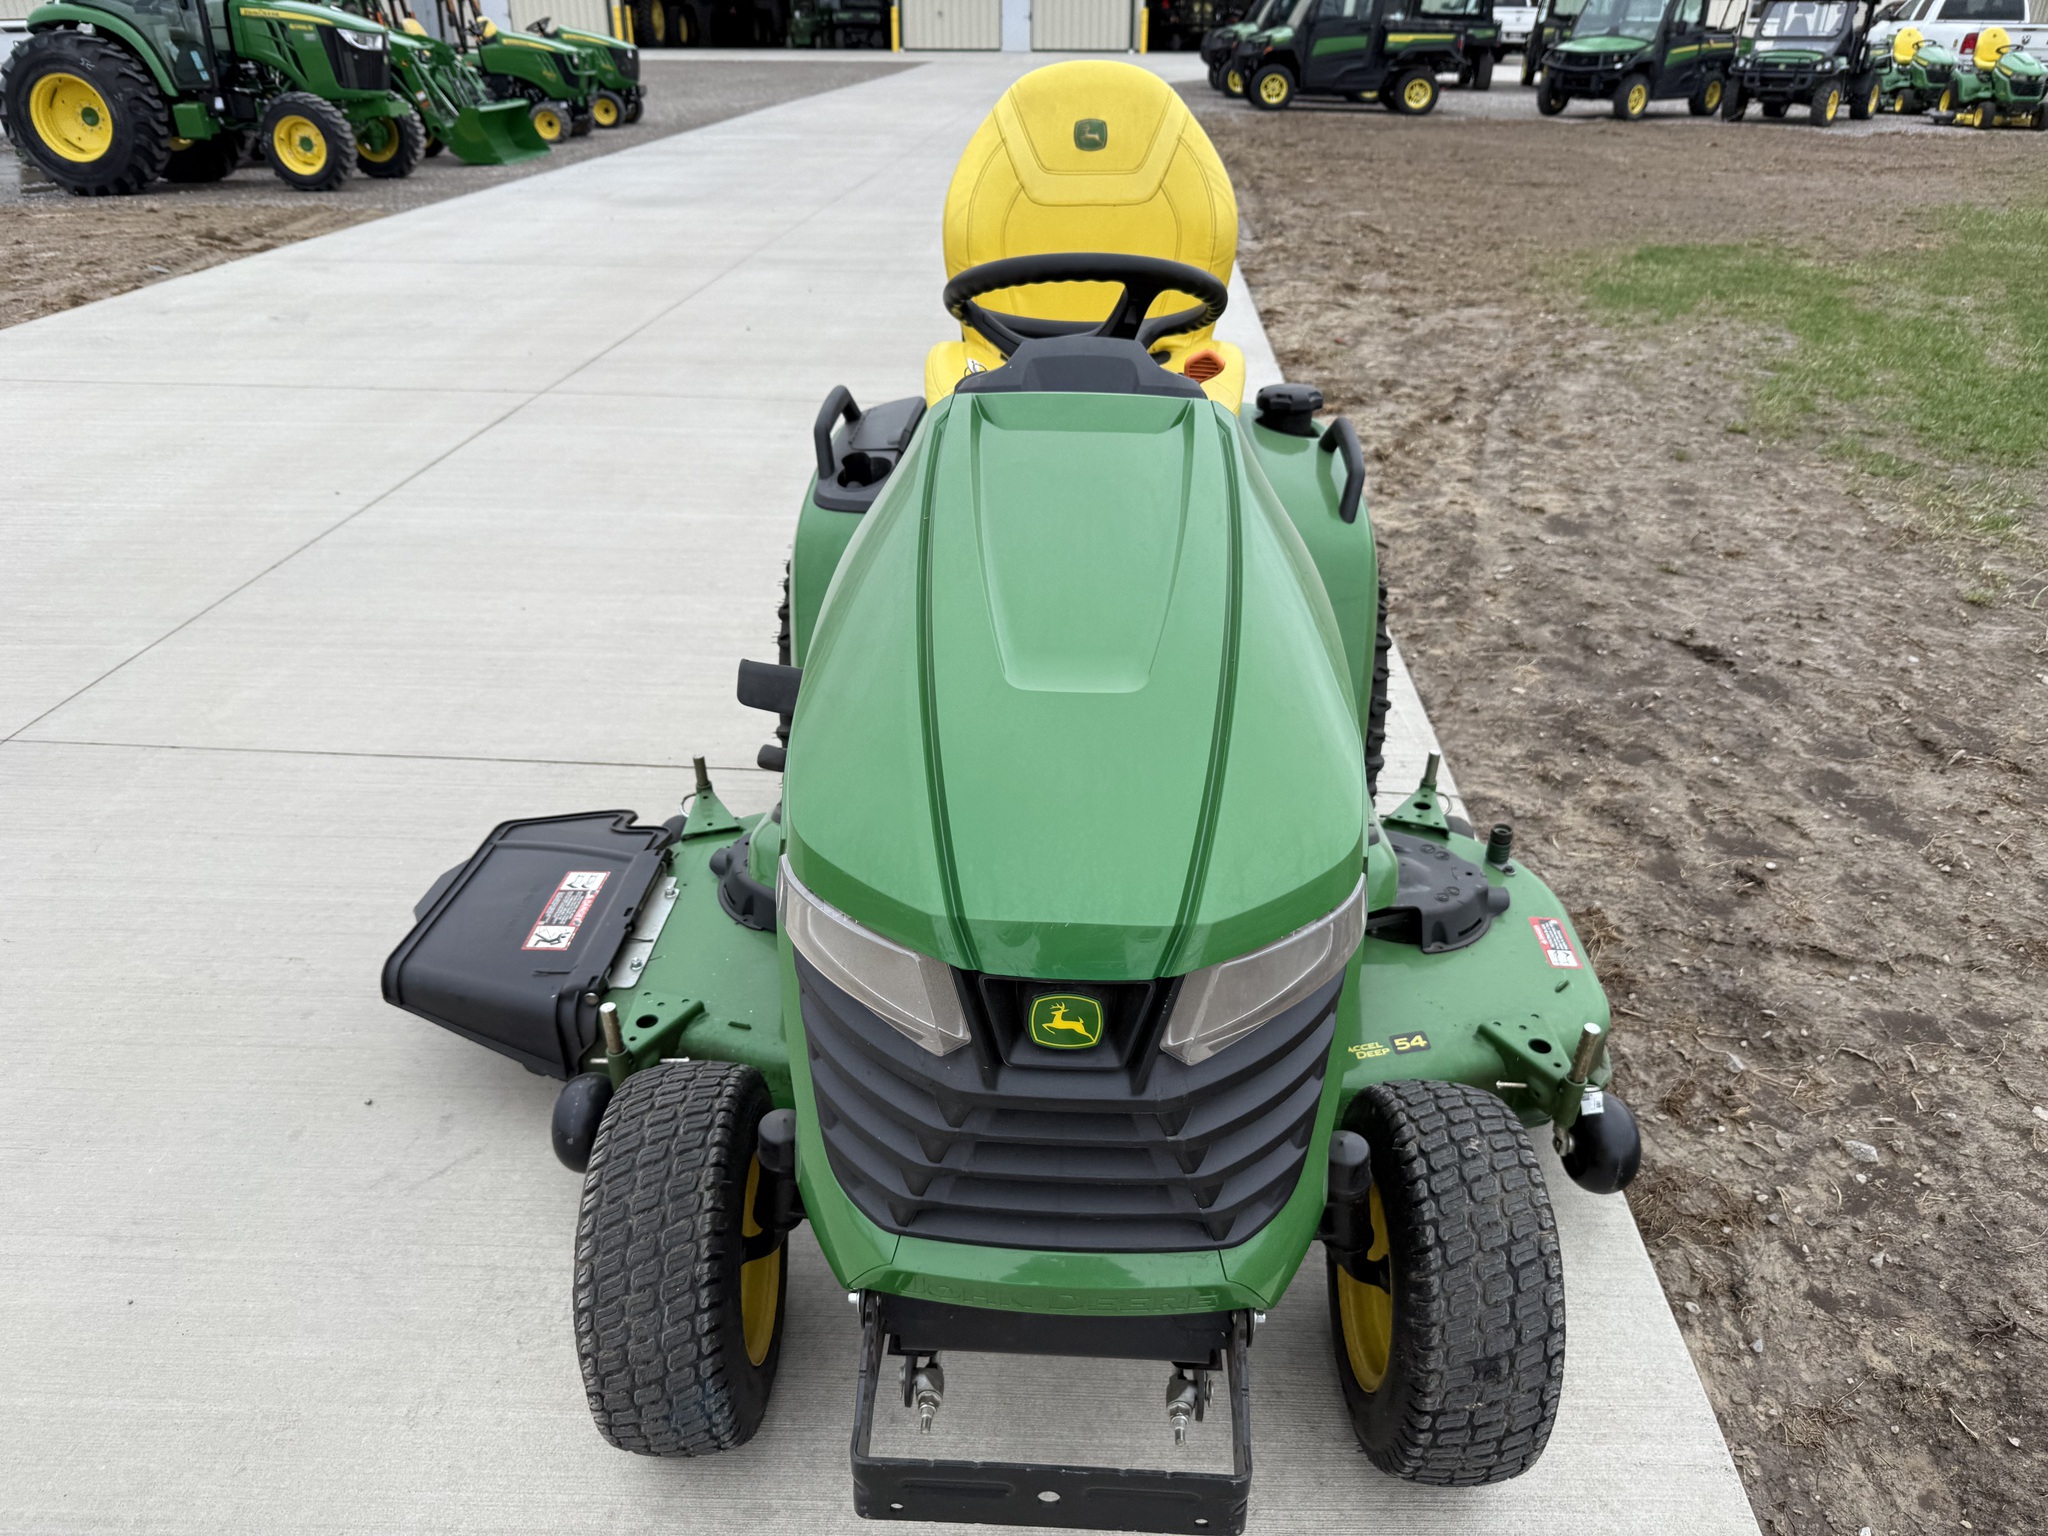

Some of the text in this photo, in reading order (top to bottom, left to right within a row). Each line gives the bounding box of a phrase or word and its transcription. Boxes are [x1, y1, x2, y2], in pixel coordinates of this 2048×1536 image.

[1394, 1034, 1428, 1050] 54
[1355, 1047, 1390, 1060] DEEP
[900, 1276, 1219, 1312] JOHN DEERE
